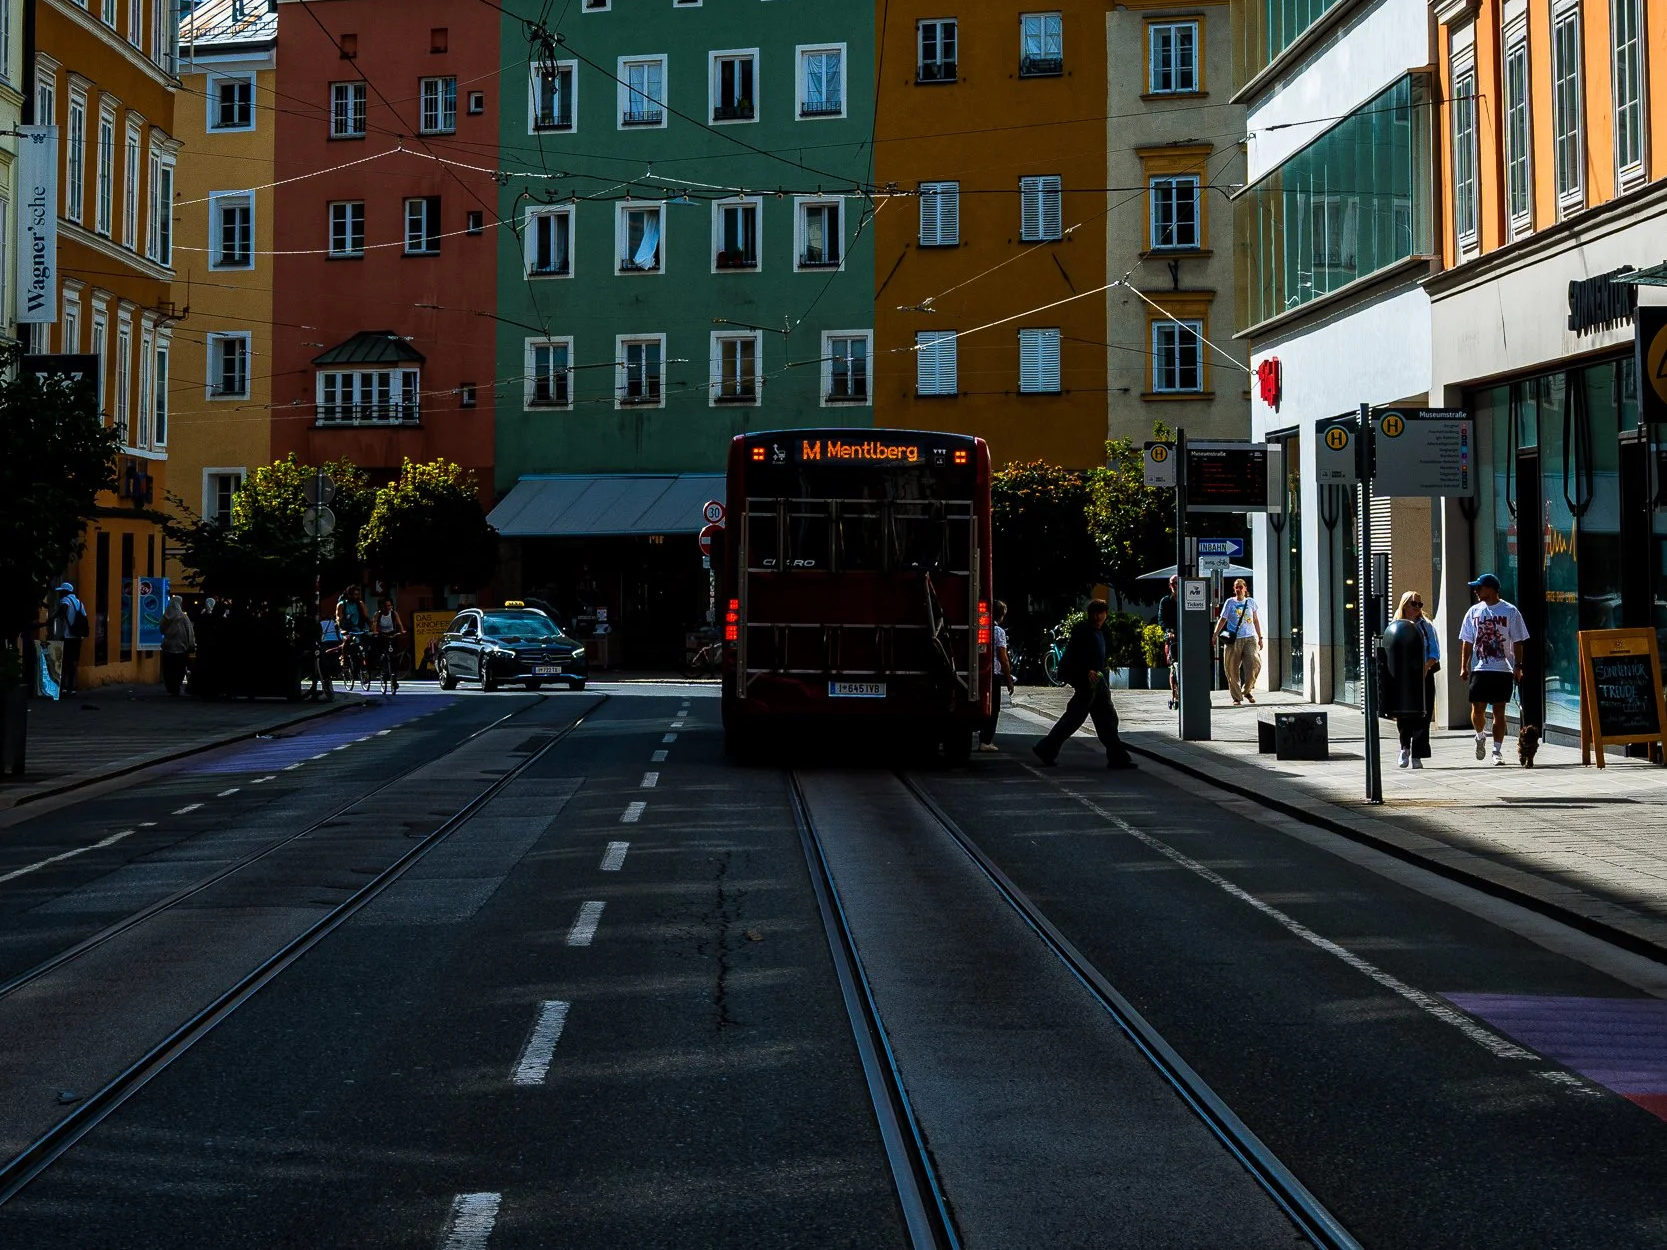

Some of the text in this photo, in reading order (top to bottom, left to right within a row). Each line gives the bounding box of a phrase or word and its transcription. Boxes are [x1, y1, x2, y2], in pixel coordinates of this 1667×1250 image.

[27, 186, 50, 313] Wagner'sche
[1419, 410, 1467, 418] Museumstraße
[1387, 419, 1398, 433] H
[1331, 432, 1342, 446] H
[802, 440, 919, 461] M Mentlberg
[708, 507, 720, 519] 30
[1200, 543, 1226, 551] INBAHN
[416, 614, 432, 622] DAS
[416, 621, 450, 629] KINOFES
